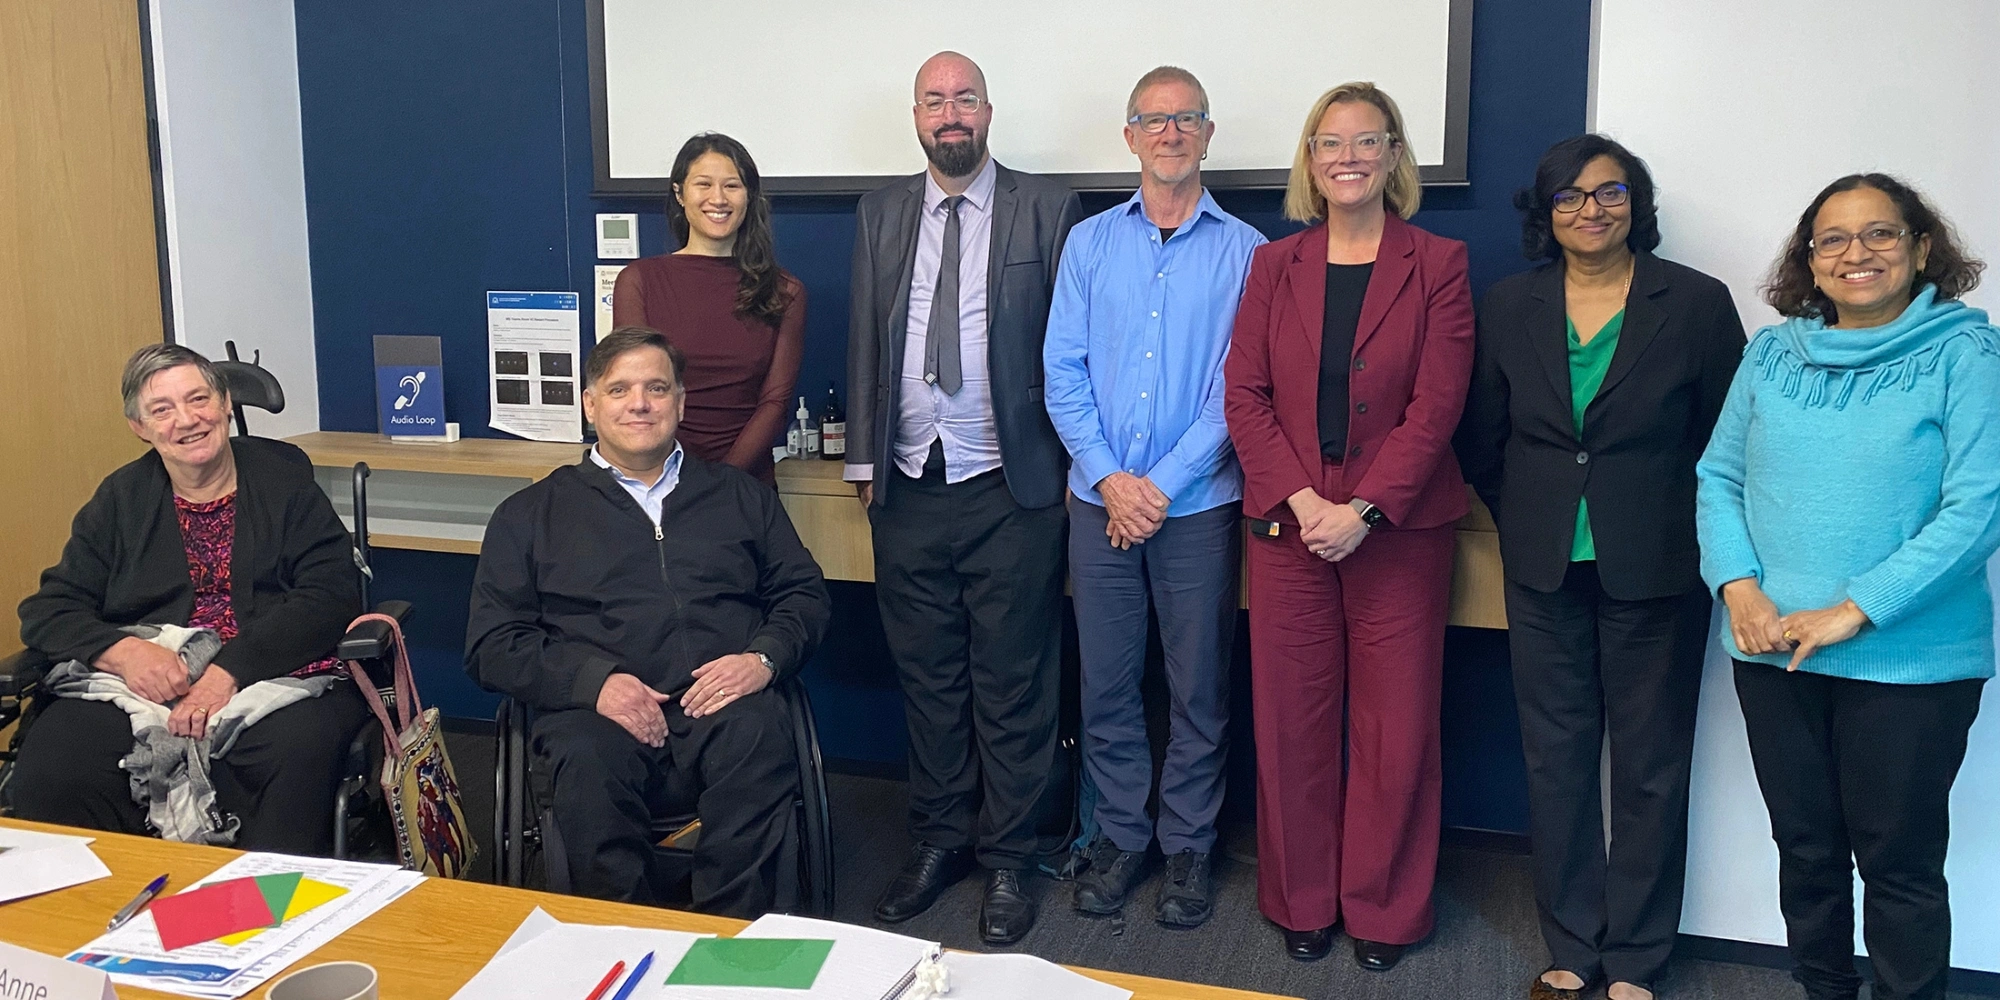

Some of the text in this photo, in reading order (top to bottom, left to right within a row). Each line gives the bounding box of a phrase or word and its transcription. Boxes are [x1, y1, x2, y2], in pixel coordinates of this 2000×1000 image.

[390, 415, 436, 426] Audio Loop
[0, 968, 48, 1000] Anne
